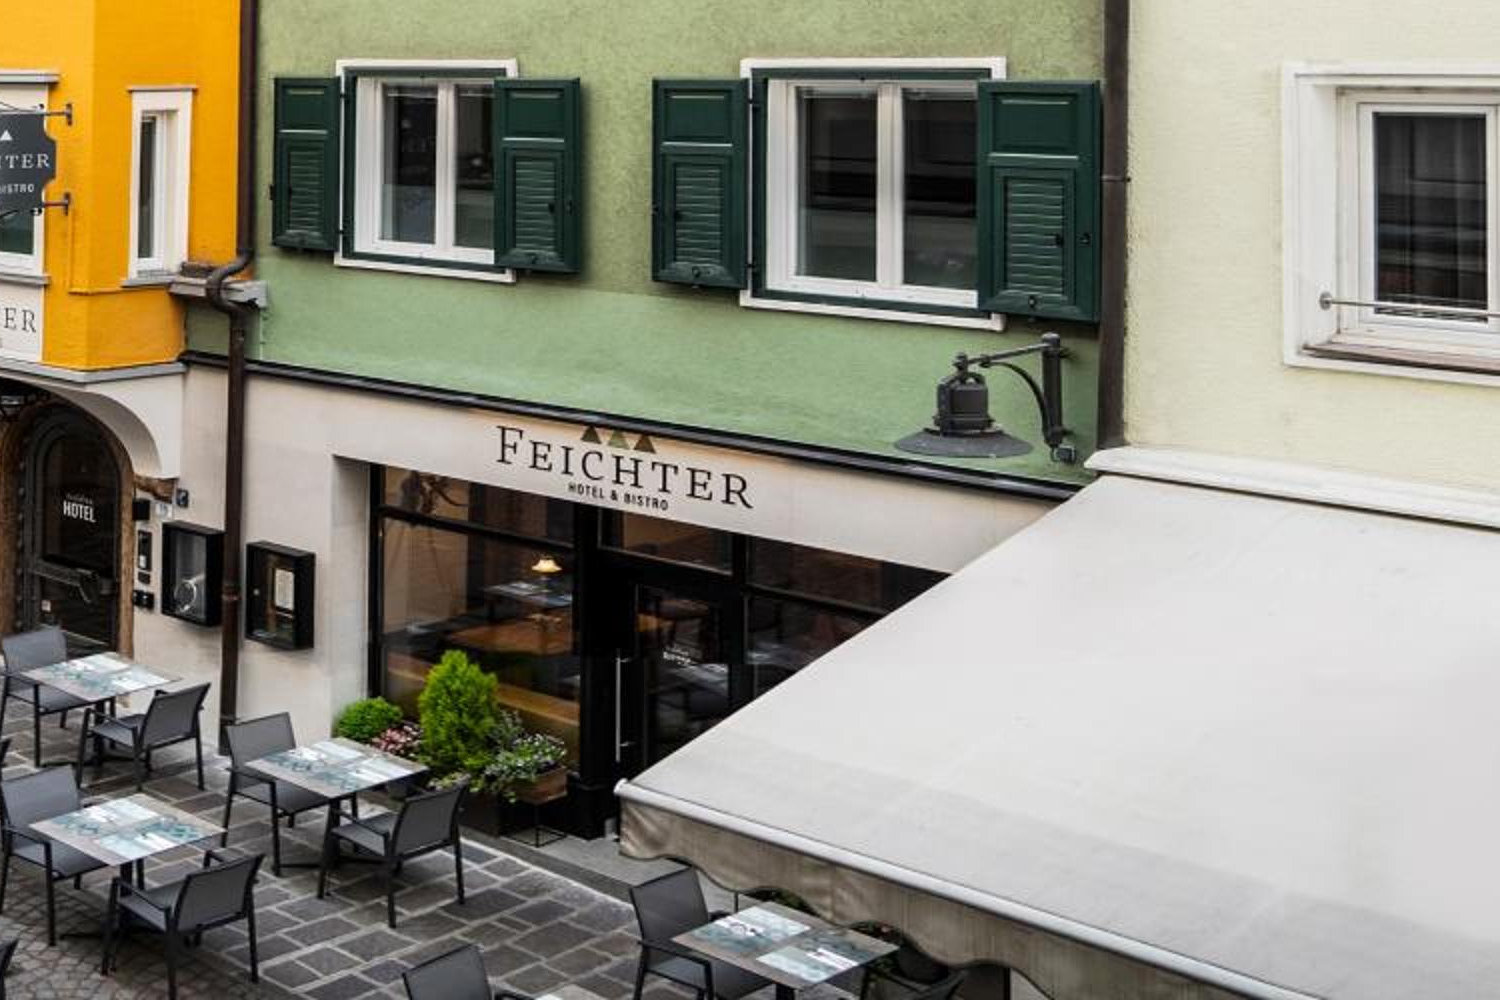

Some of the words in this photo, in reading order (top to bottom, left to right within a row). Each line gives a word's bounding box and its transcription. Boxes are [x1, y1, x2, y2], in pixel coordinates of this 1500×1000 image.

[496, 425, 754, 509] FEICHTER
[568, 482, 605, 499] HOTEL
[609, 490, 619, 502] &
[623, 494, 670, 511] BISTRO
[63, 500, 97, 524] HOTEL
